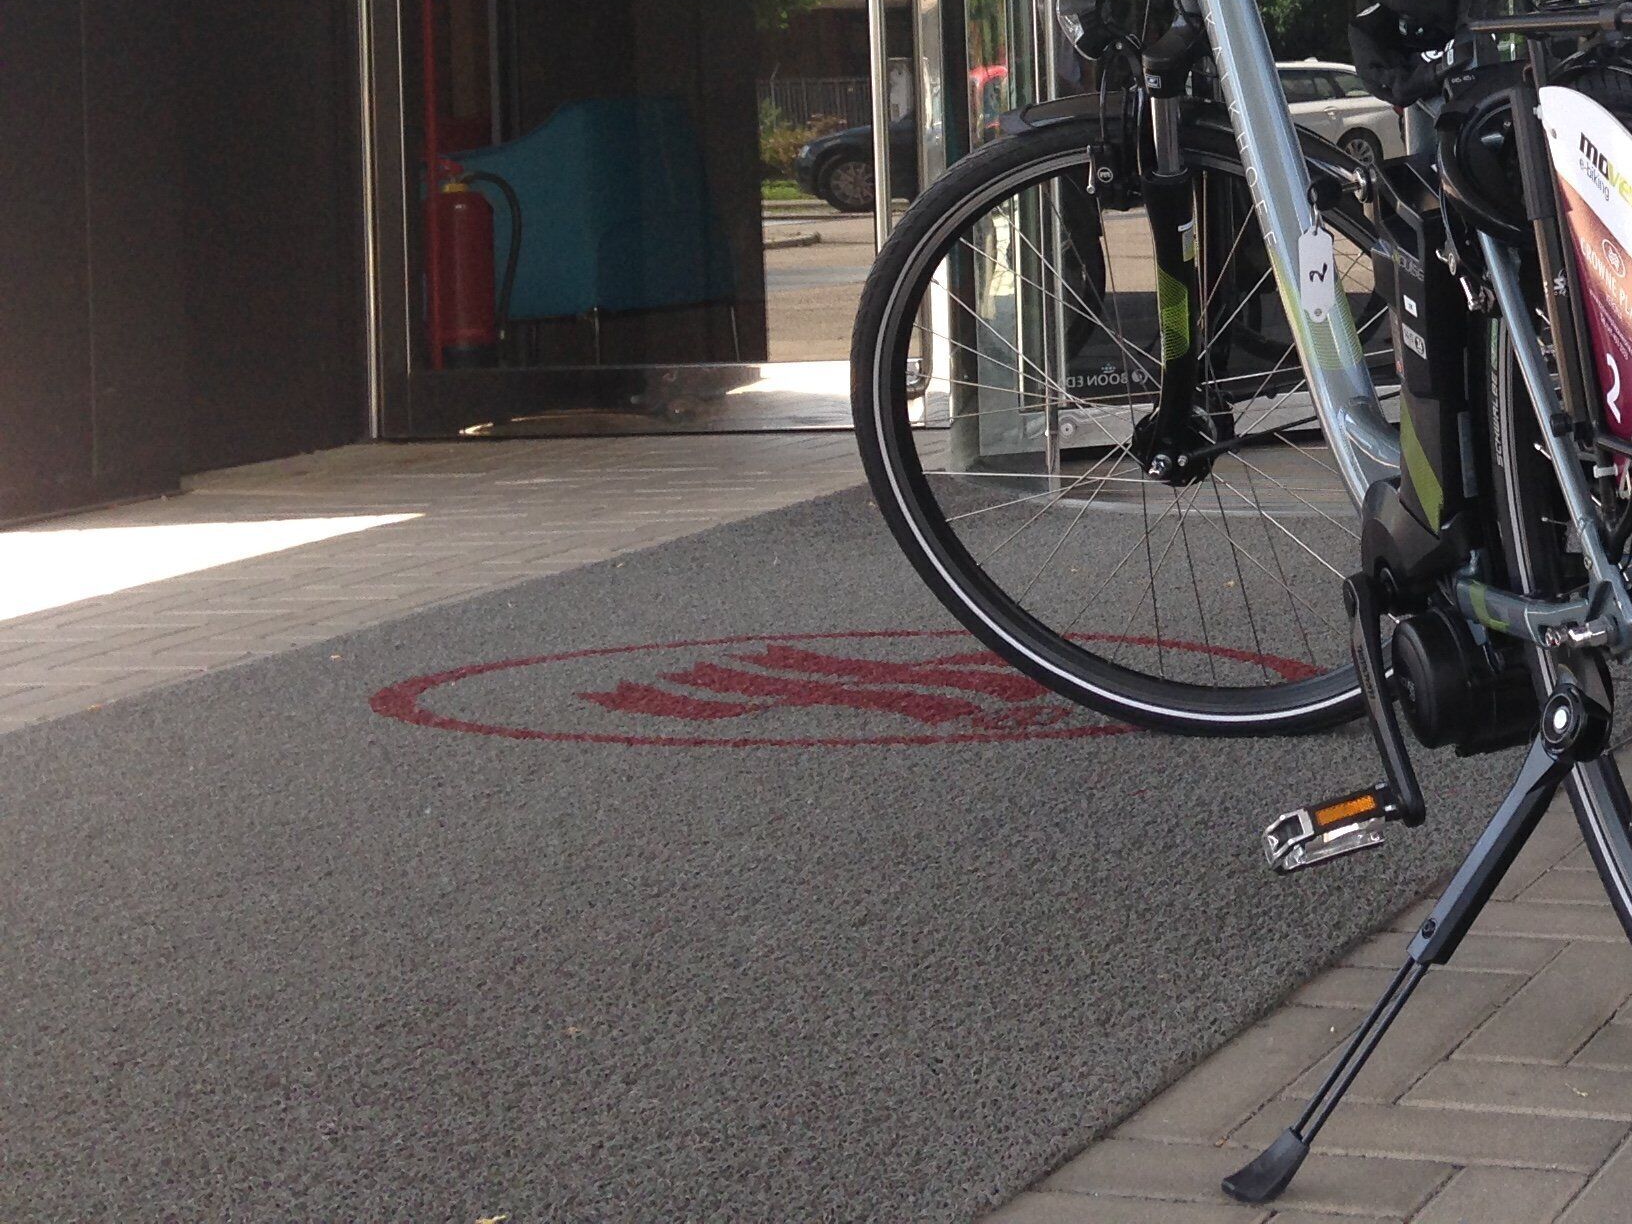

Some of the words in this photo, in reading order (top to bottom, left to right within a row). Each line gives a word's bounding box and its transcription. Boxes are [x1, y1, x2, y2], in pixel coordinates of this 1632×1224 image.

[1203, 11, 1278, 247] KALKHOFF
[1579, 158, 1611, 202] e-biking
[1580, 237, 1618, 294] CROWNE
[1606, 353, 1621, 424] 2
